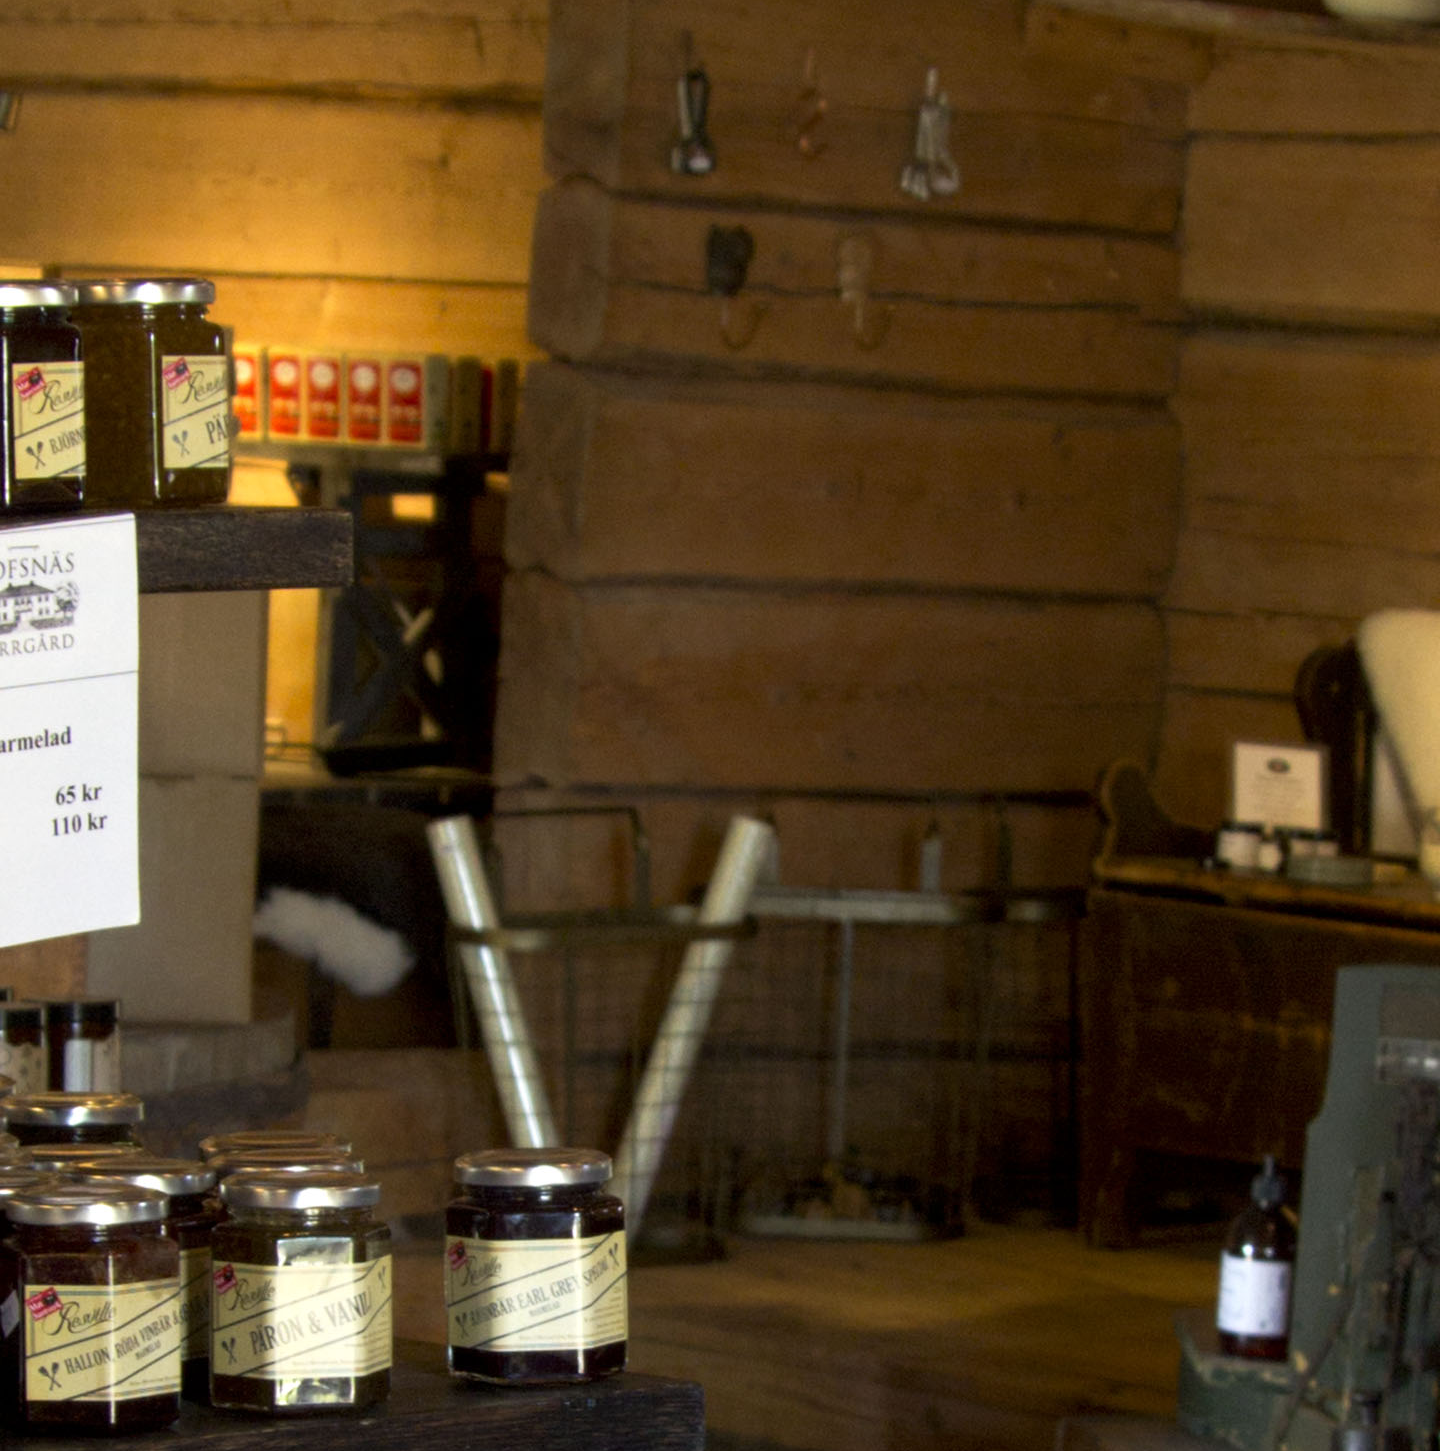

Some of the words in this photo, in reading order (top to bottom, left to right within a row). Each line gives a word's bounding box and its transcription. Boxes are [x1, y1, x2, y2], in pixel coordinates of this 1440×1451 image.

[55, 784, 77, 806] 65
[81, 782, 103, 803] kr
[51, 814, 82, 837] 110
[87, 812, 108, 833] kr
[517, 1287, 550, 1309] EARL
[550, 1274, 581, 1298] GREY
[309, 1310, 324, 1334] &
